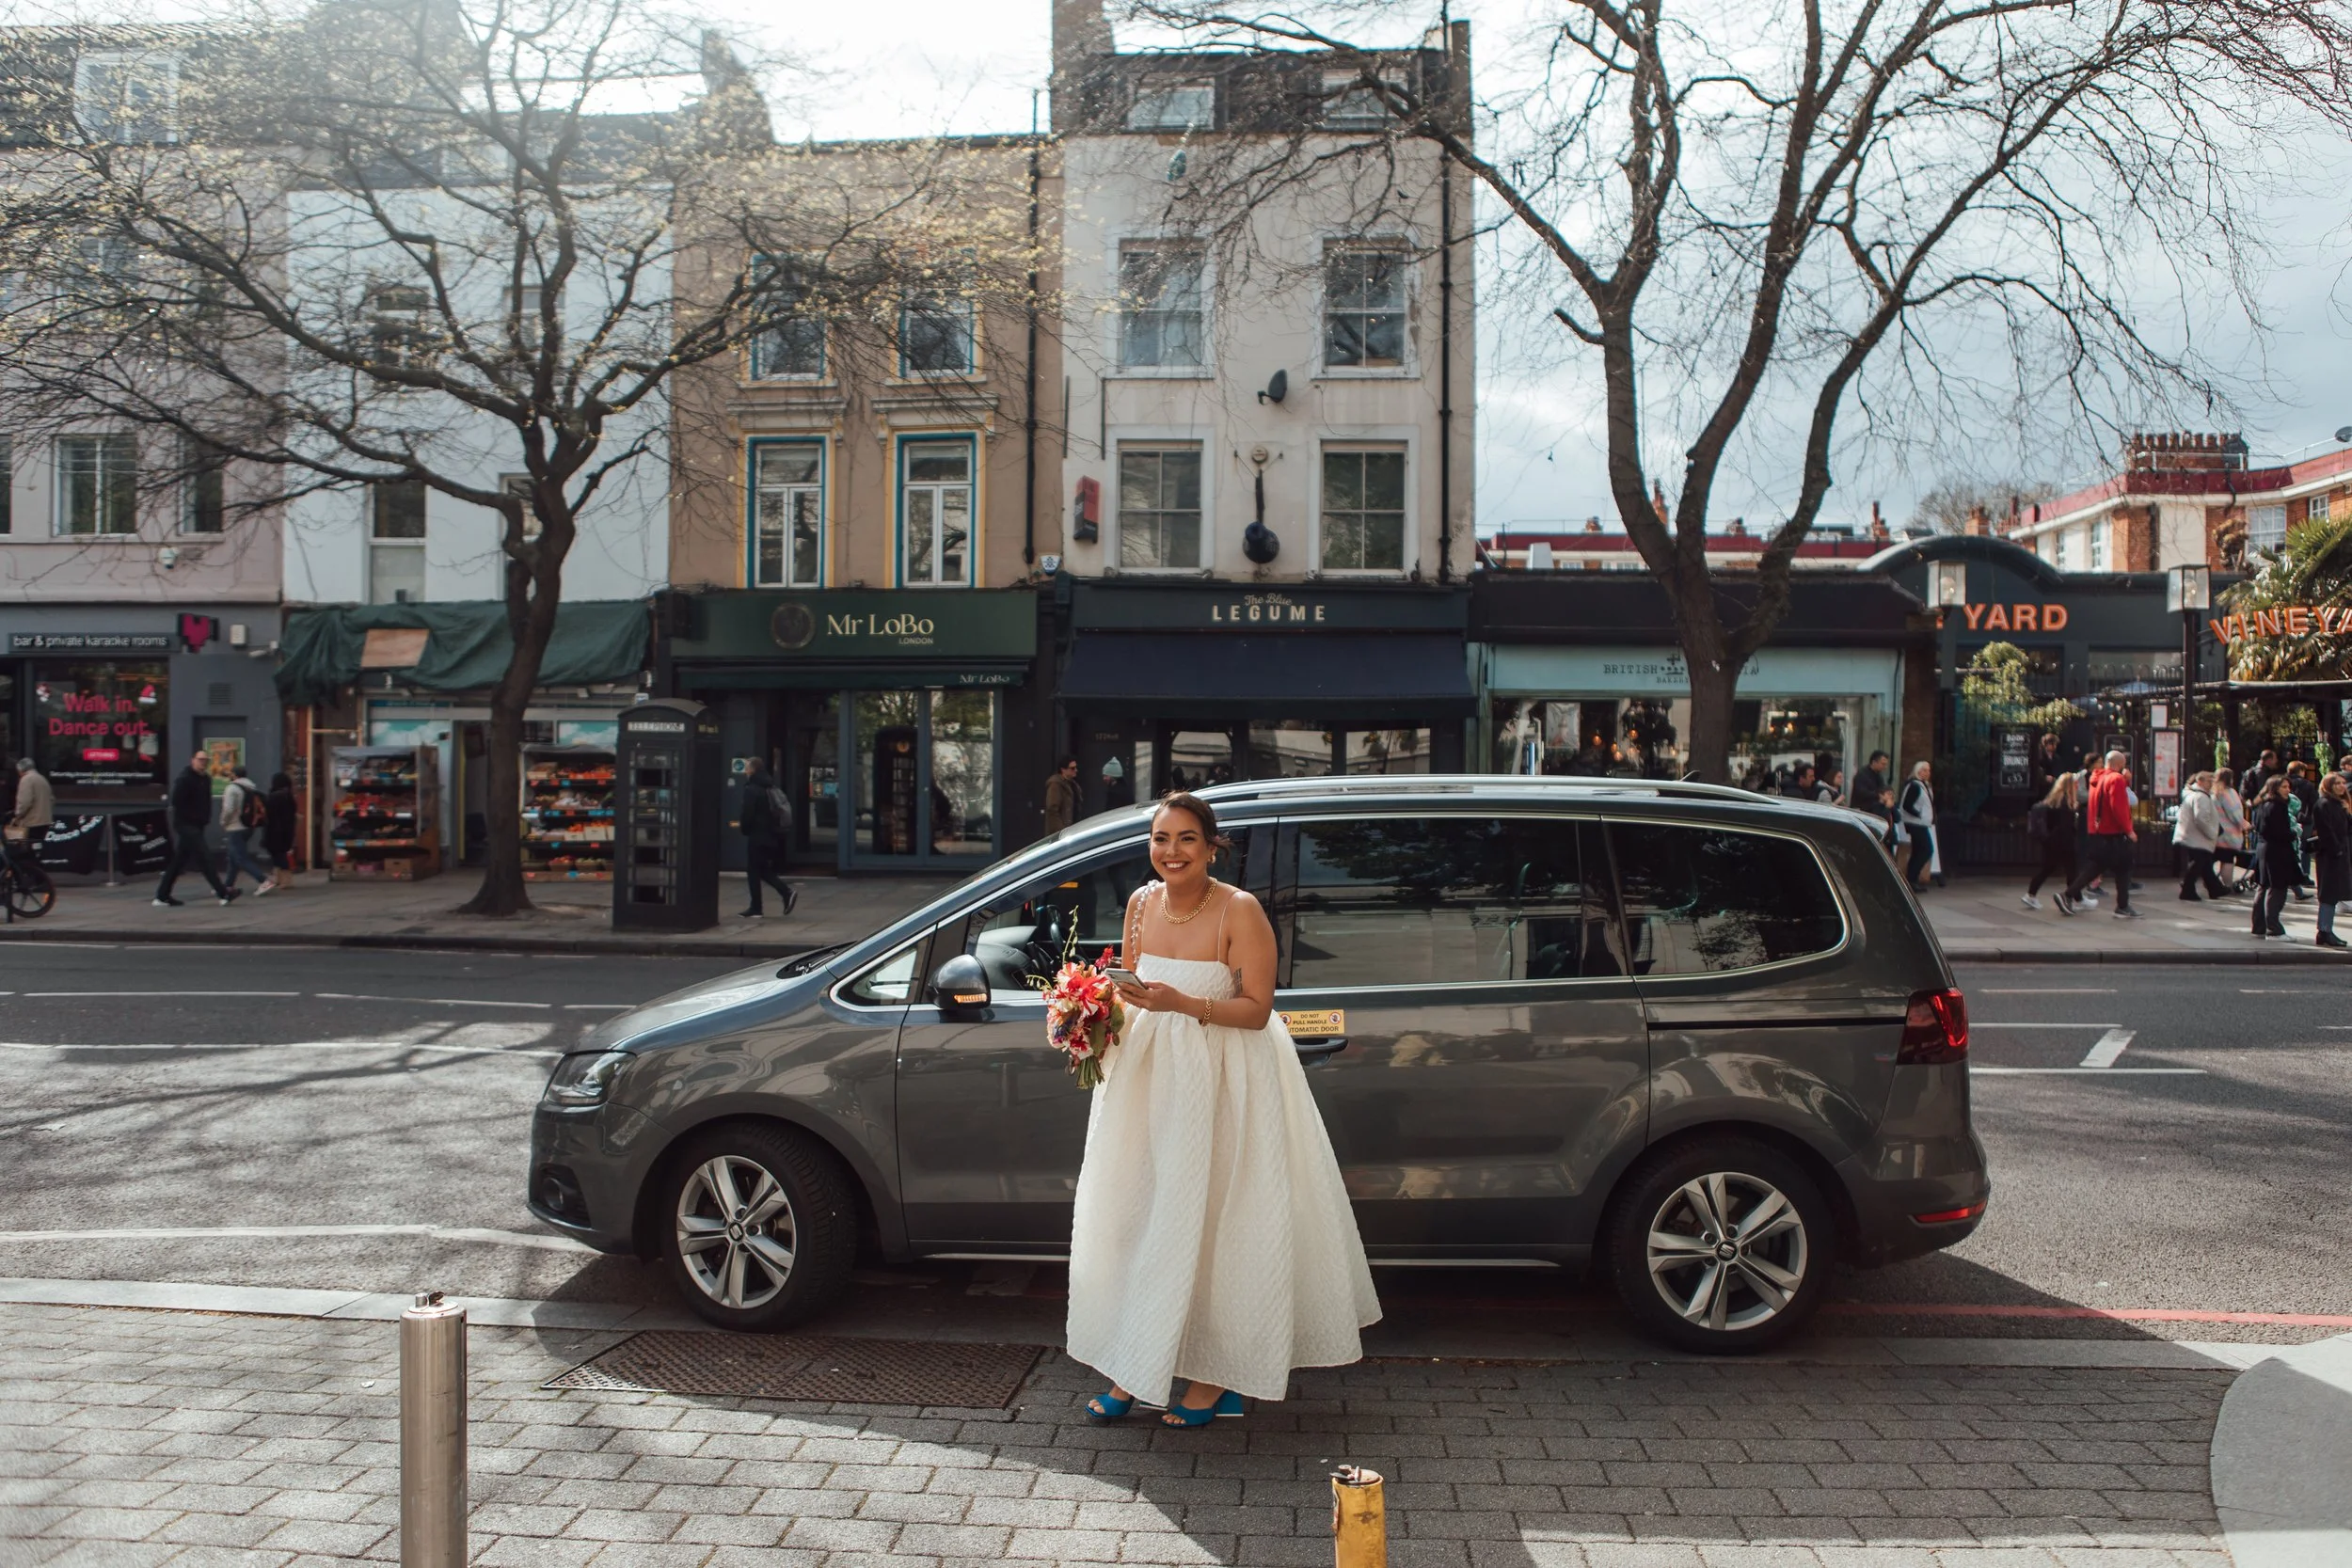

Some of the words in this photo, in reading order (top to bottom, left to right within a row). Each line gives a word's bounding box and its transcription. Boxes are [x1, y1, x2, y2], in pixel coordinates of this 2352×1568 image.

[1244, 594, 1263, 606] The
[1265, 593, 1293, 606] Blue
[1212, 605, 1326, 621] LEGUME
[1963, 603, 2068, 630] YARD
[827, 613, 864, 635] Mr
[868, 613, 934, 635] LoBo
[13, 636, 33, 647] bar
[46, 636, 85, 648] private
[86, 635, 130, 647] karaoke
[132, 637, 168, 647] rooms
[1602, 664, 1659, 674] BRITISH
[960, 674, 978, 684] Mr
[979, 674, 1010, 684] LoBo
[1656, 676, 1690, 685] BAKERY
[62, 692, 110, 713] Walk
[115, 694, 138, 713] in.
[48, 718, 109, 736] Dance
[629, 723, 683, 732] TELEPHONE
